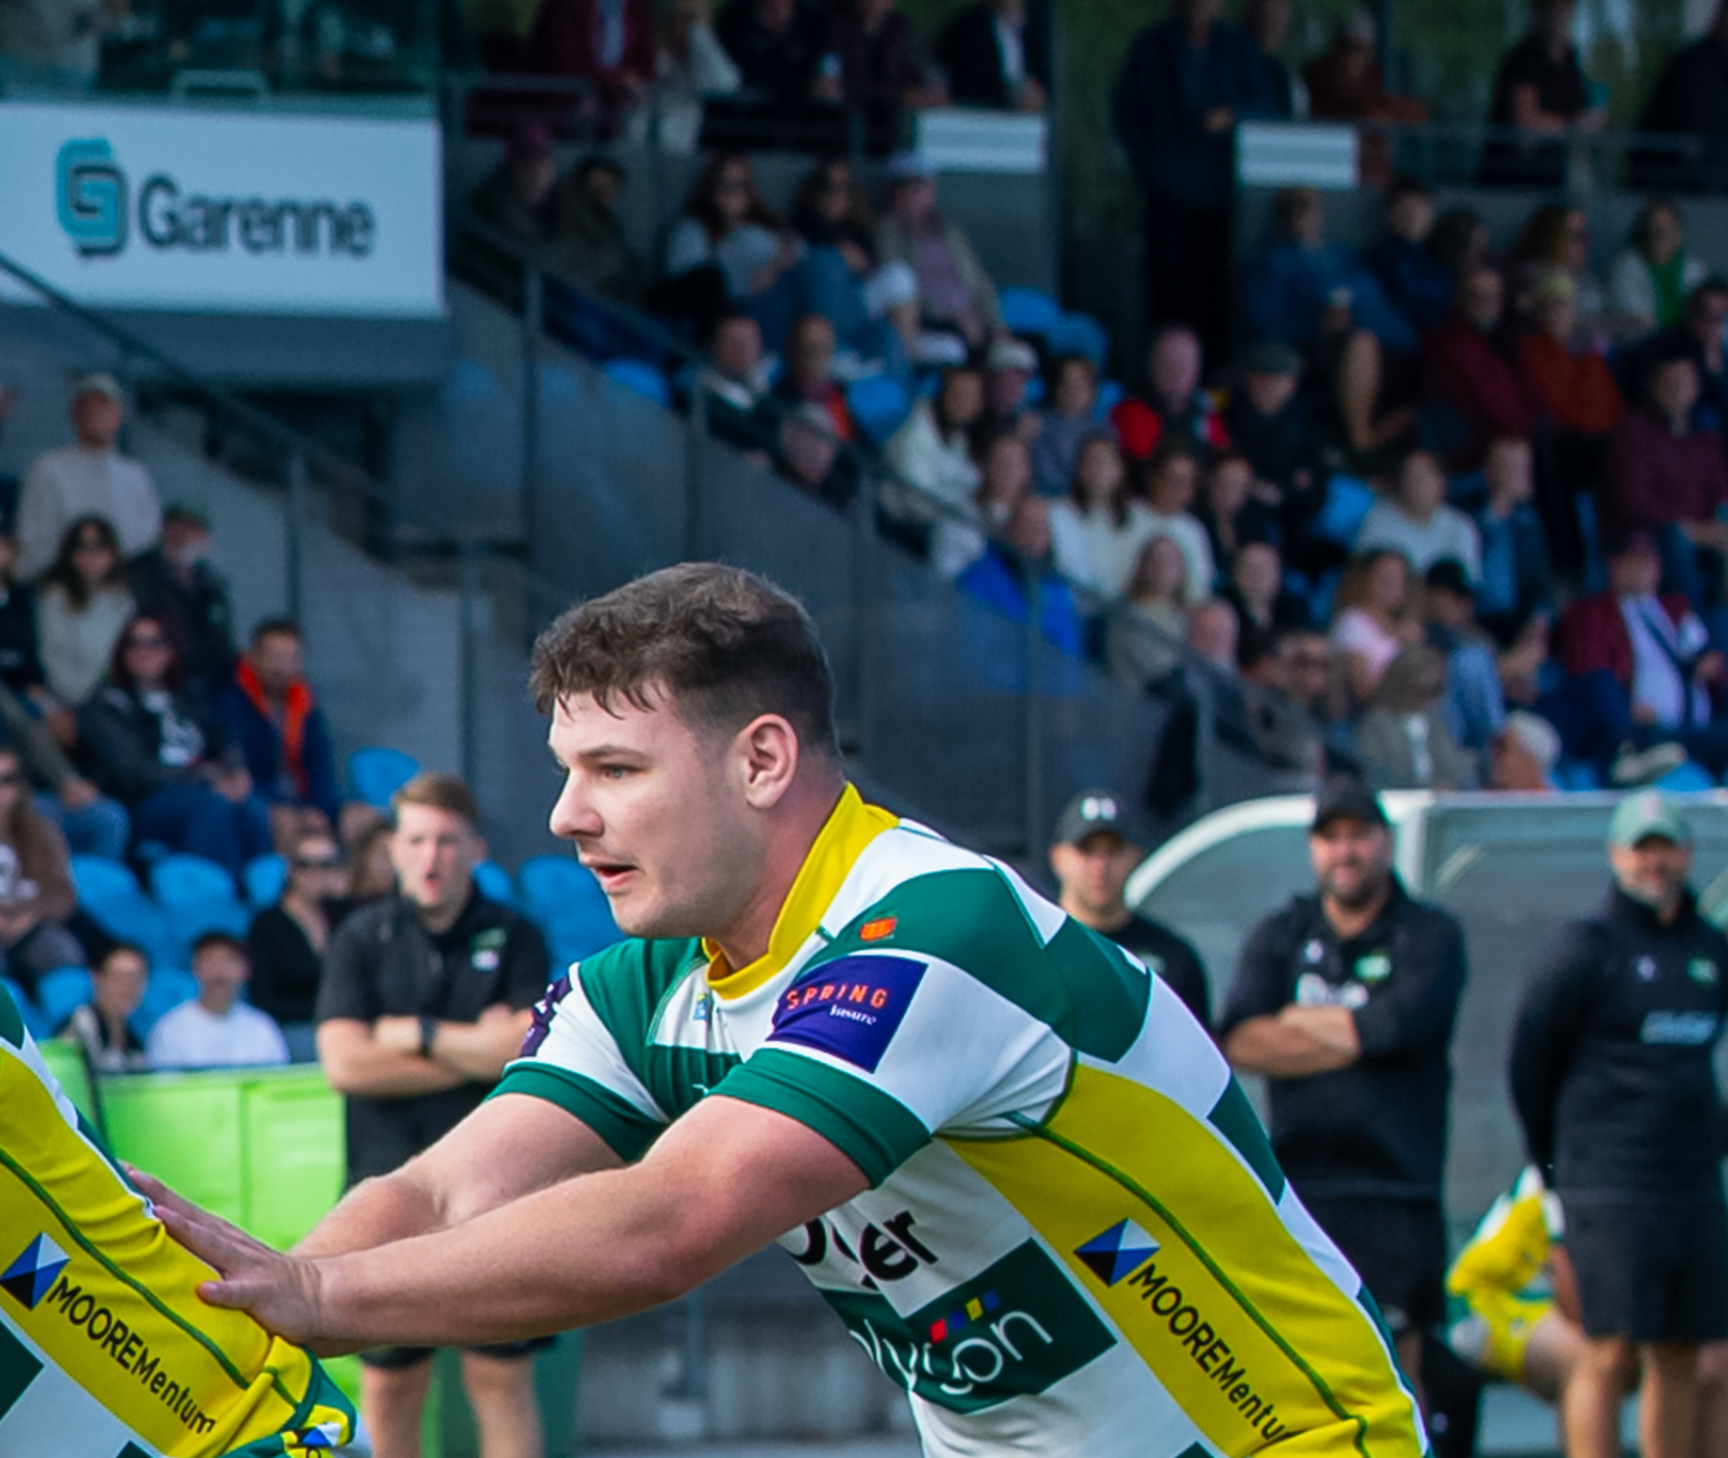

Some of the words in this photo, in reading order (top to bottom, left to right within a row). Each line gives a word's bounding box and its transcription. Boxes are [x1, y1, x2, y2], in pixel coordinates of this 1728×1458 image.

[138, 172, 375, 257] Garenne
[786, 984, 888, 1009] SPRING
[46, 1276, 216, 1434] MOOREMentum
[1128, 1262, 1286, 1441] MOOREMentu
